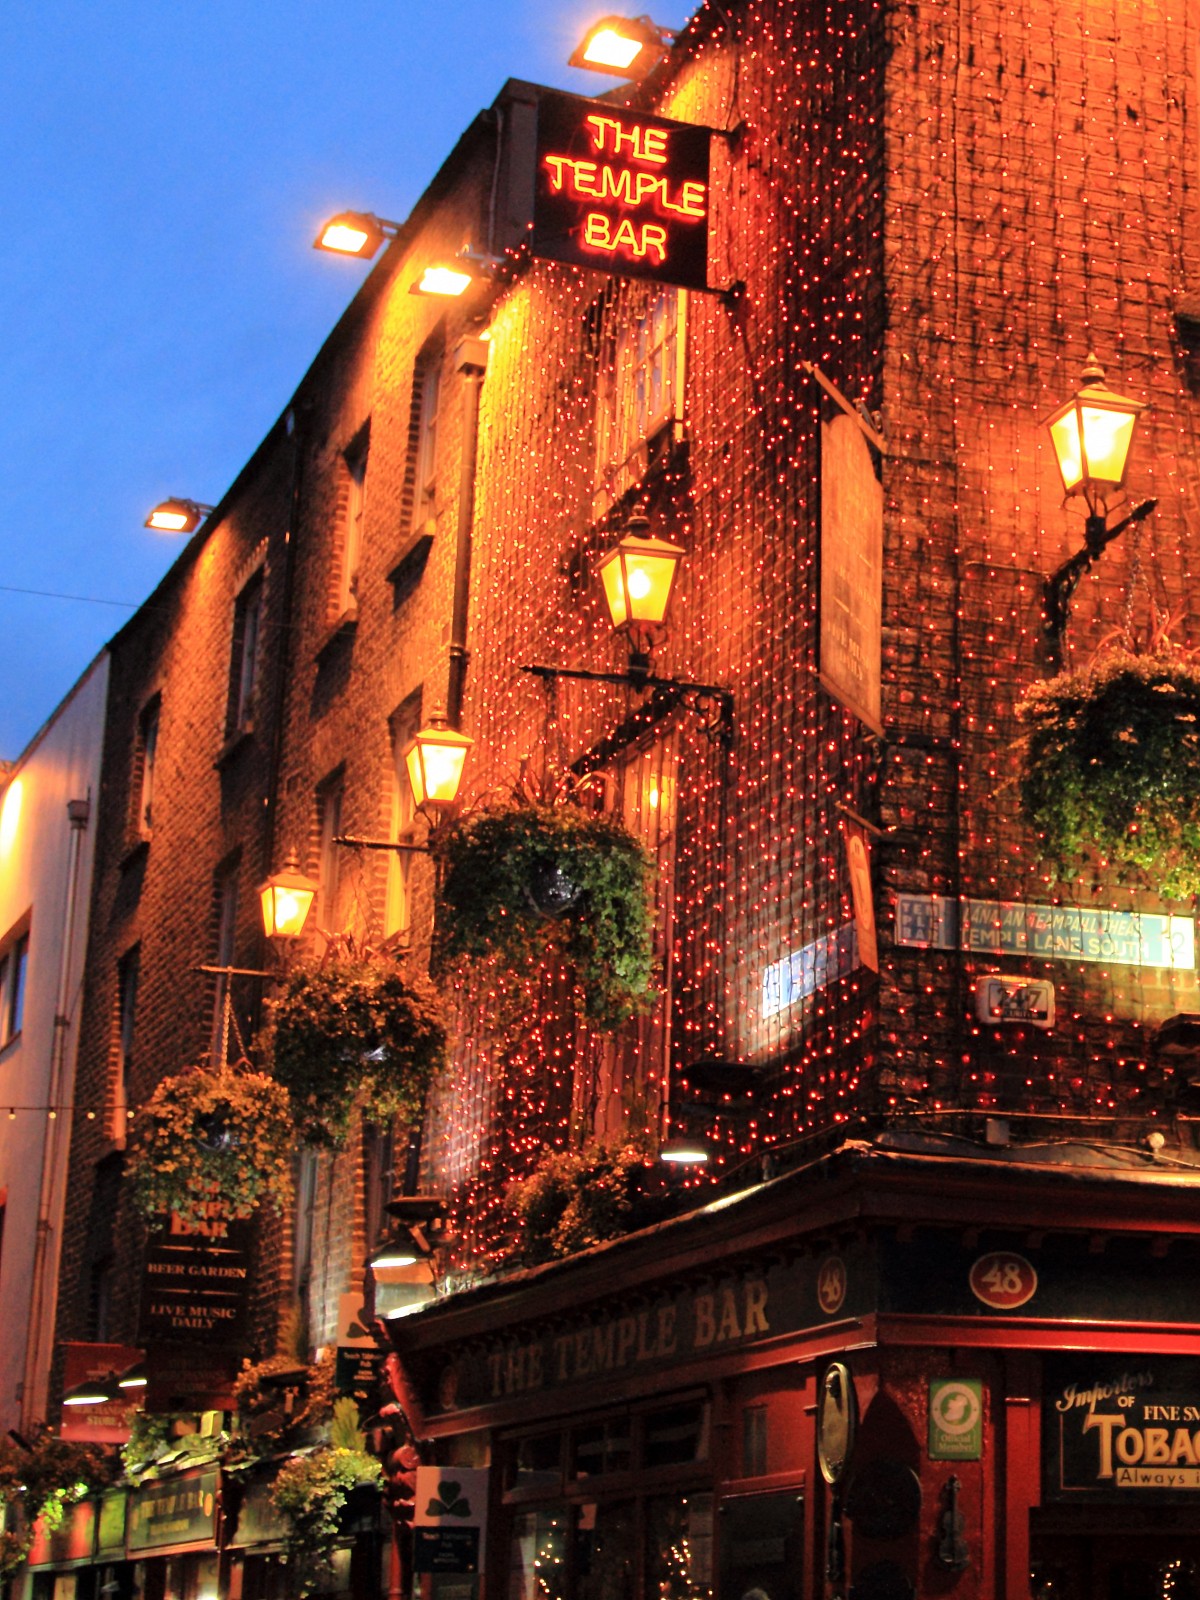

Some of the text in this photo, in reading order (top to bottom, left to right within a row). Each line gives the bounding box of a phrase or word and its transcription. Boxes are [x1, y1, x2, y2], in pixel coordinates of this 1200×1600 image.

[587, 115, 668, 163] THE
[545, 156, 706, 217] TEMPLE
[585, 213, 667, 261] BAR
[1002, 910, 1026, 927] AN
[1034, 935, 1082, 954] LANE
[1088, 938, 1151, 960] SOUTH
[147, 1263, 248, 1280] BEER GARDEN
[982, 1260, 1024, 1294] 48
[822, 1268, 841, 1303] 48
[150, 1303, 237, 1320] LIVE MUSIC
[171, 1316, 217, 1330] DAILY
[486, 1350, 544, 1397] THE
[554, 1305, 679, 1381] TEMPLE
[693, 1279, 770, 1348] BAR
[1056, 1371, 1154, 1413] Importers
[1117, 1395, 1136, 1408] OF
[1143, 1405, 1180, 1421] FINE
[1119, 1468, 1186, 1487] Always
